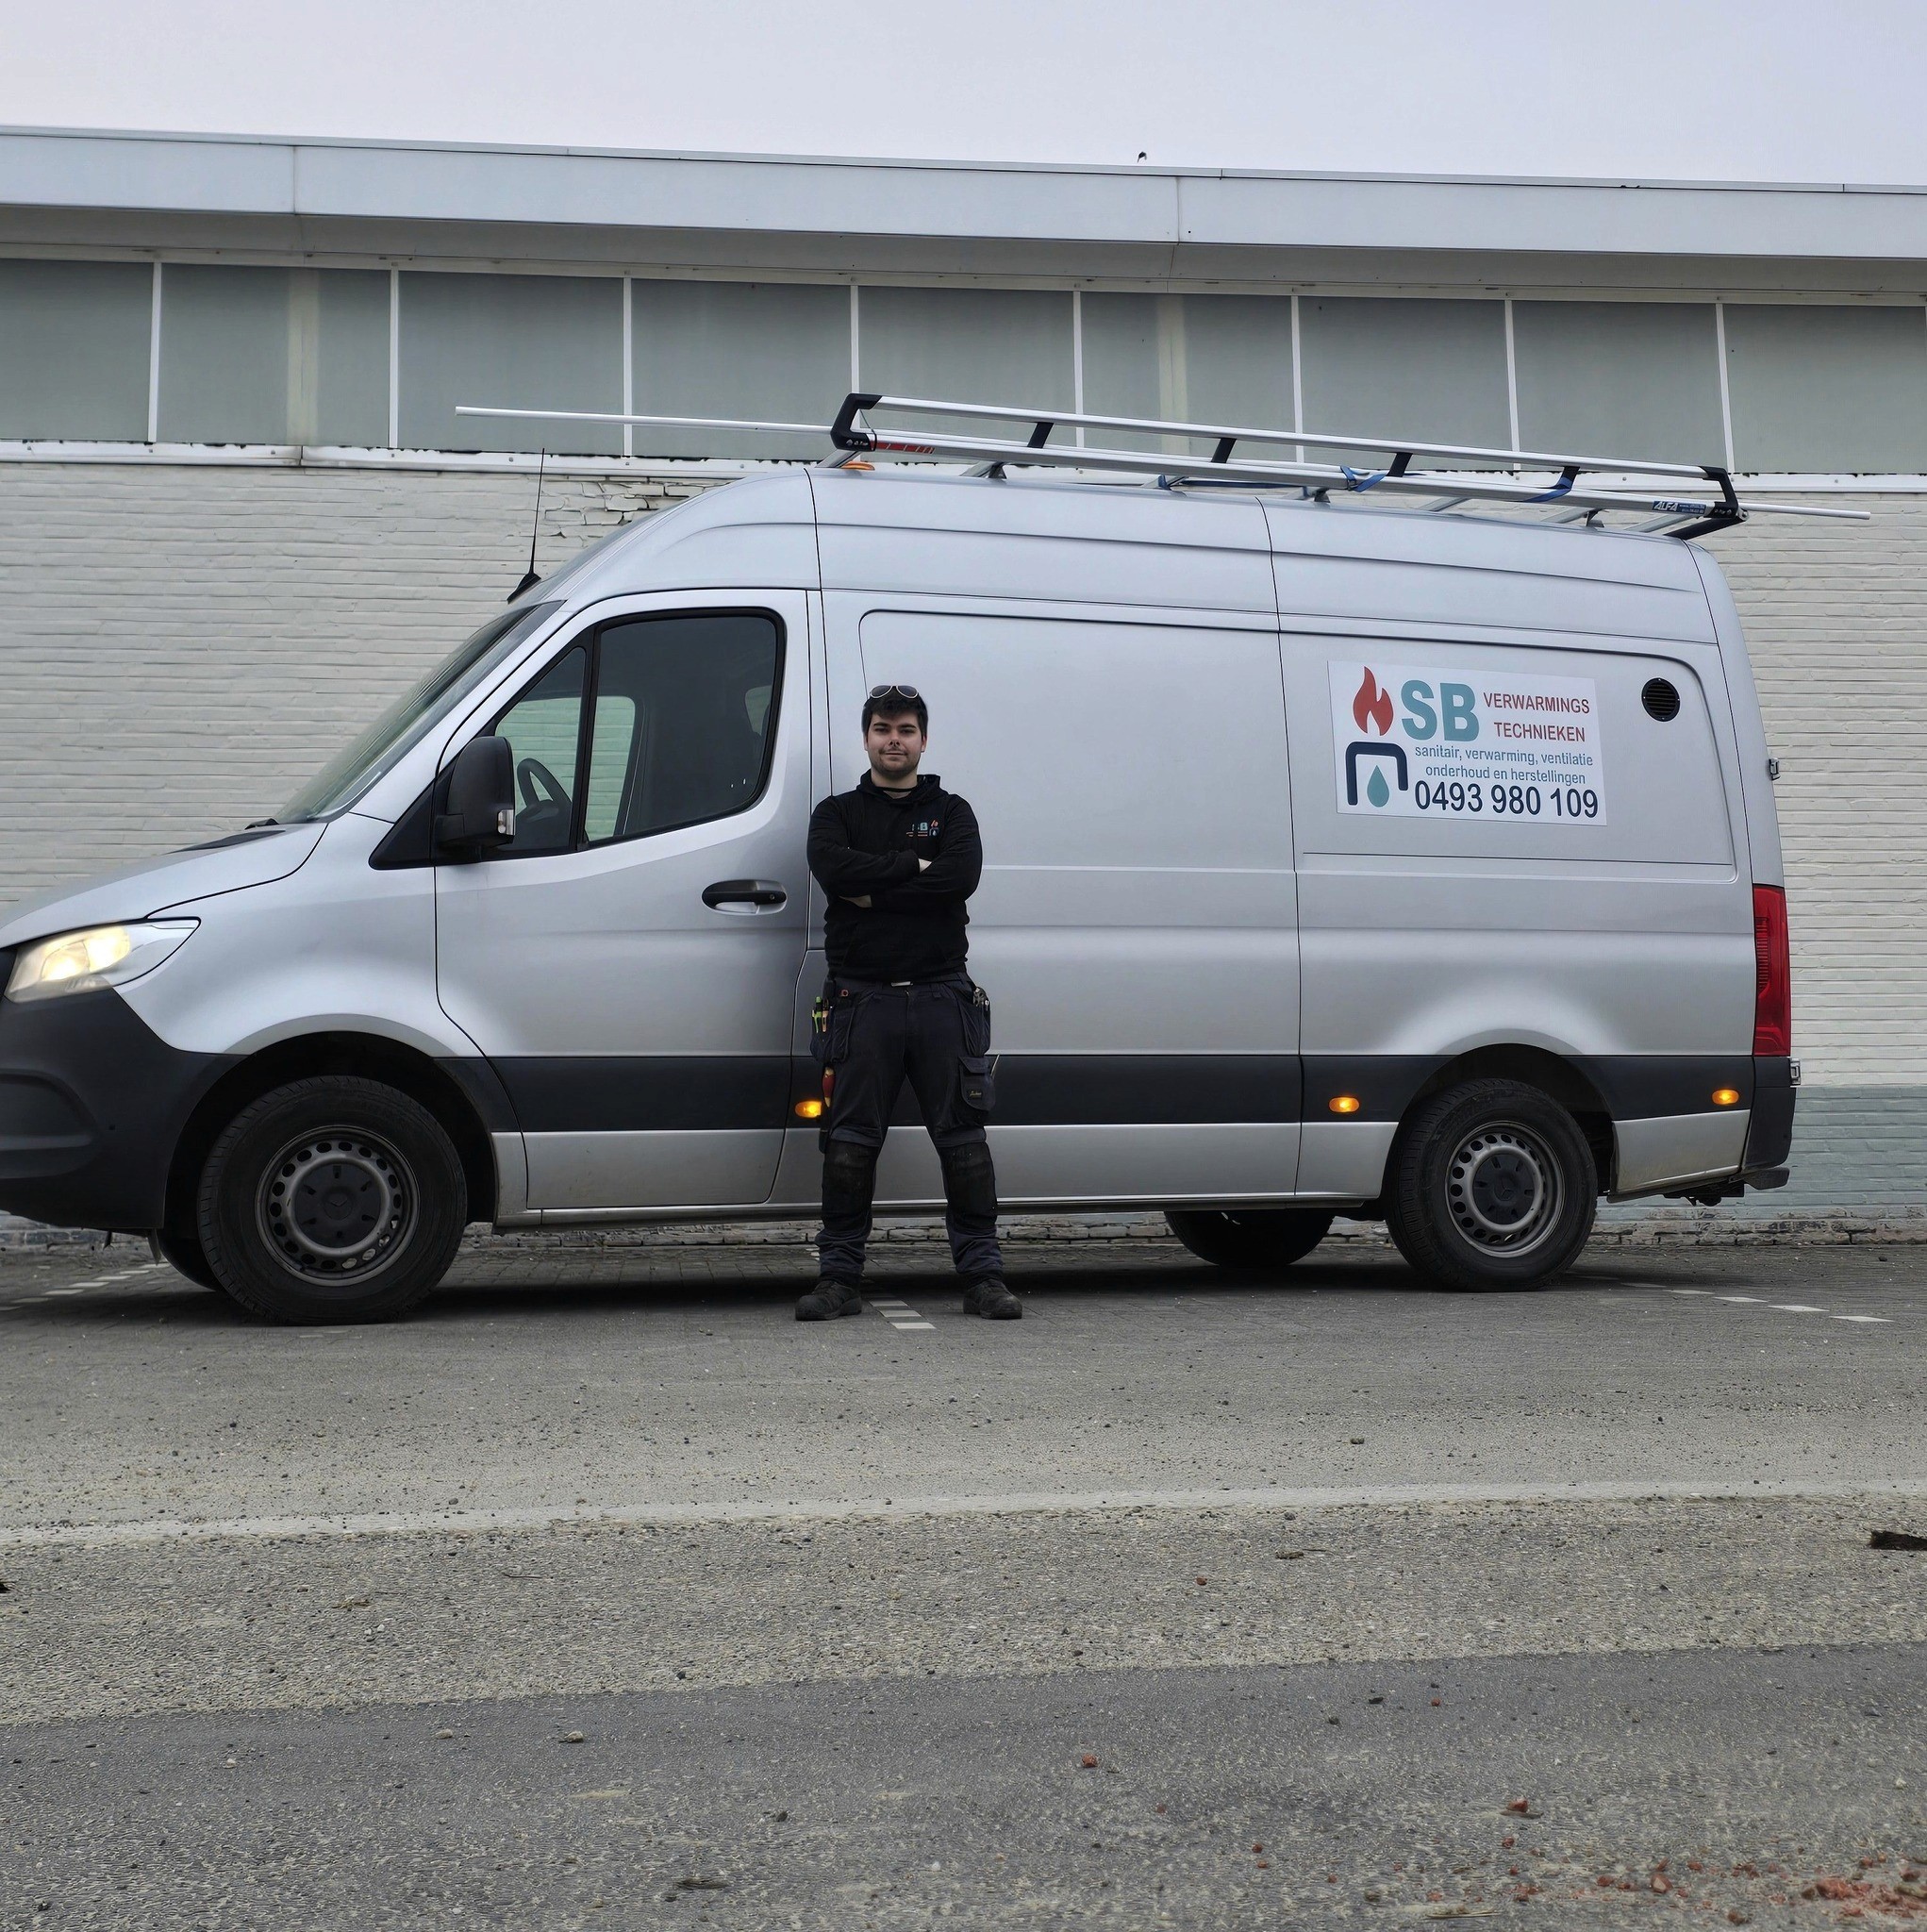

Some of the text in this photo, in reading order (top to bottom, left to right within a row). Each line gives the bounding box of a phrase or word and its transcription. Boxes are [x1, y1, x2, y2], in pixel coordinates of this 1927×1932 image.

[1653, 502, 1677, 511] ALFA
[1401, 679, 1480, 741] SB
[1483, 691, 1590, 714] VERWARMINGS
[1494, 722, 1586, 742] TECHNIEKEN
[1415, 744, 1593, 766] sanitair, verwarming, ventilatie
[1425, 764, 1586, 786] onderhoud en herstellingen
[1415, 780, 1599, 818] 0493 980 109
